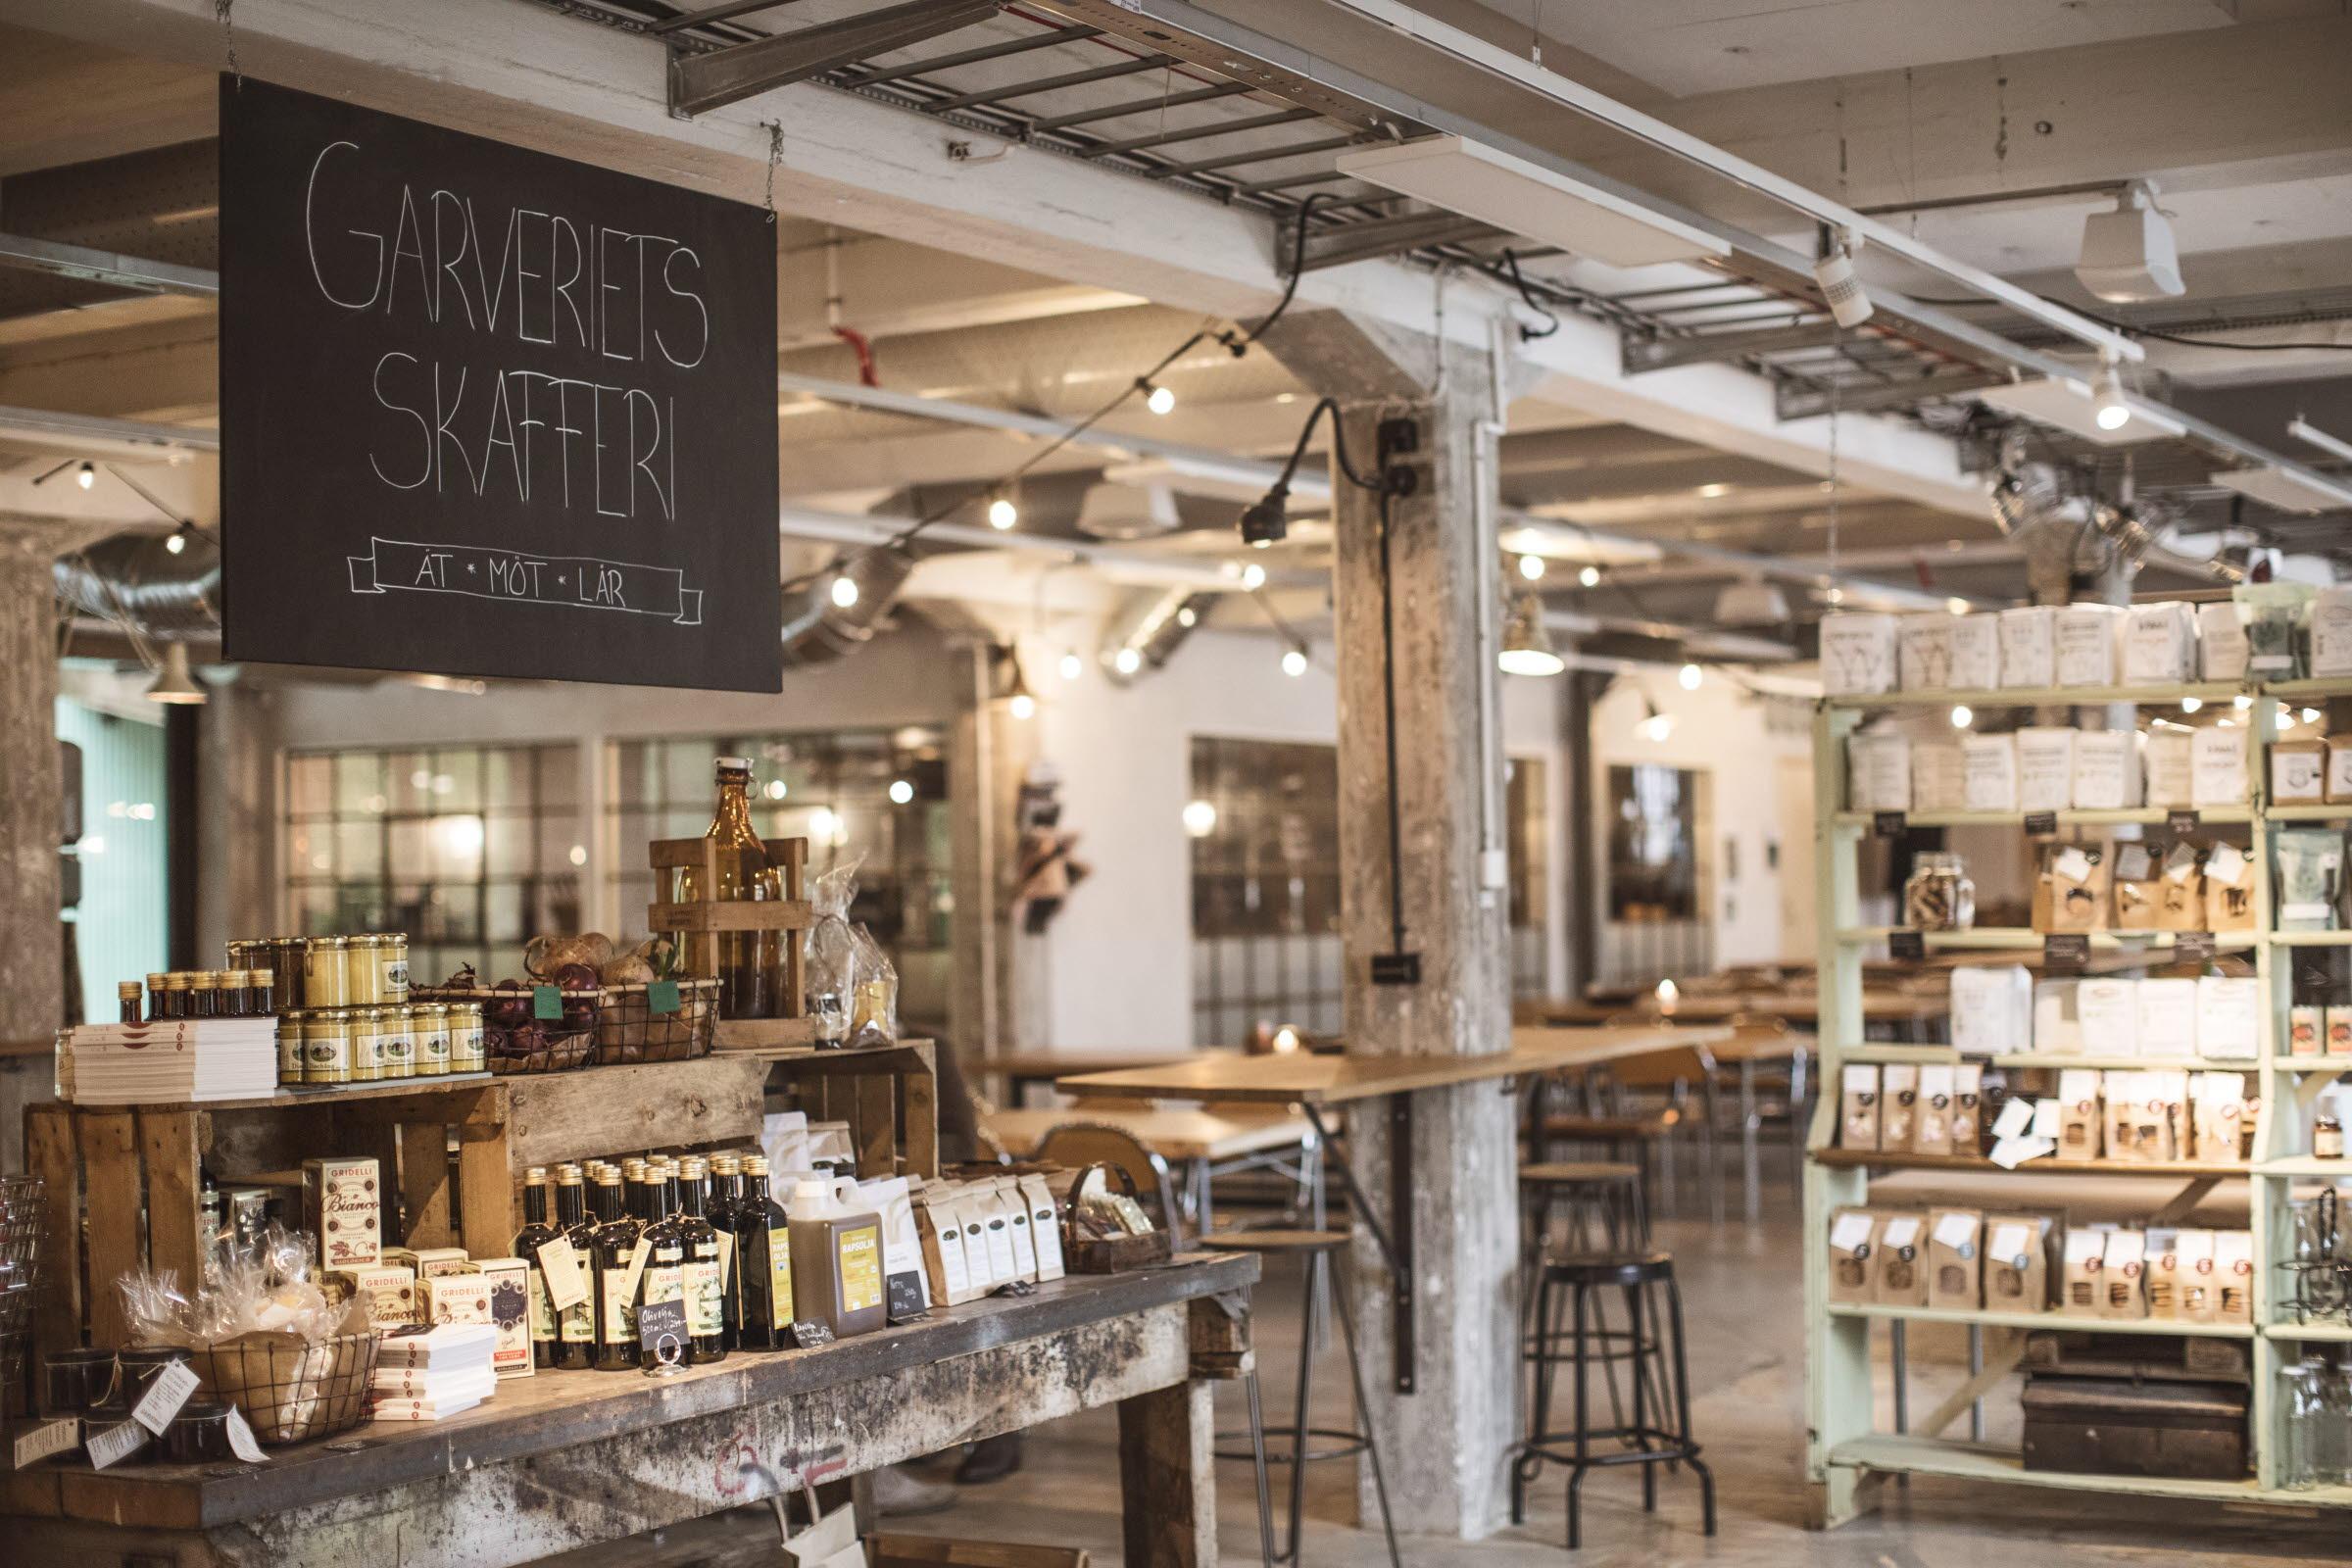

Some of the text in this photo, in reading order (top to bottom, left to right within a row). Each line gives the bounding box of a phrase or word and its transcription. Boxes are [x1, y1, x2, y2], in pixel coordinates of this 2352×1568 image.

[306, 141, 709, 368] GARVERIETS
[370, 352, 674, 521] SKAFFERI
[416, 549, 453, 588] ÄT
[490, 556, 548, 598] MÖT
[321, 1194, 380, 1213] Bianco
[366, 1277, 407, 1287] GRIDELLI
[441, 1287, 484, 1297] GRIDELLI
